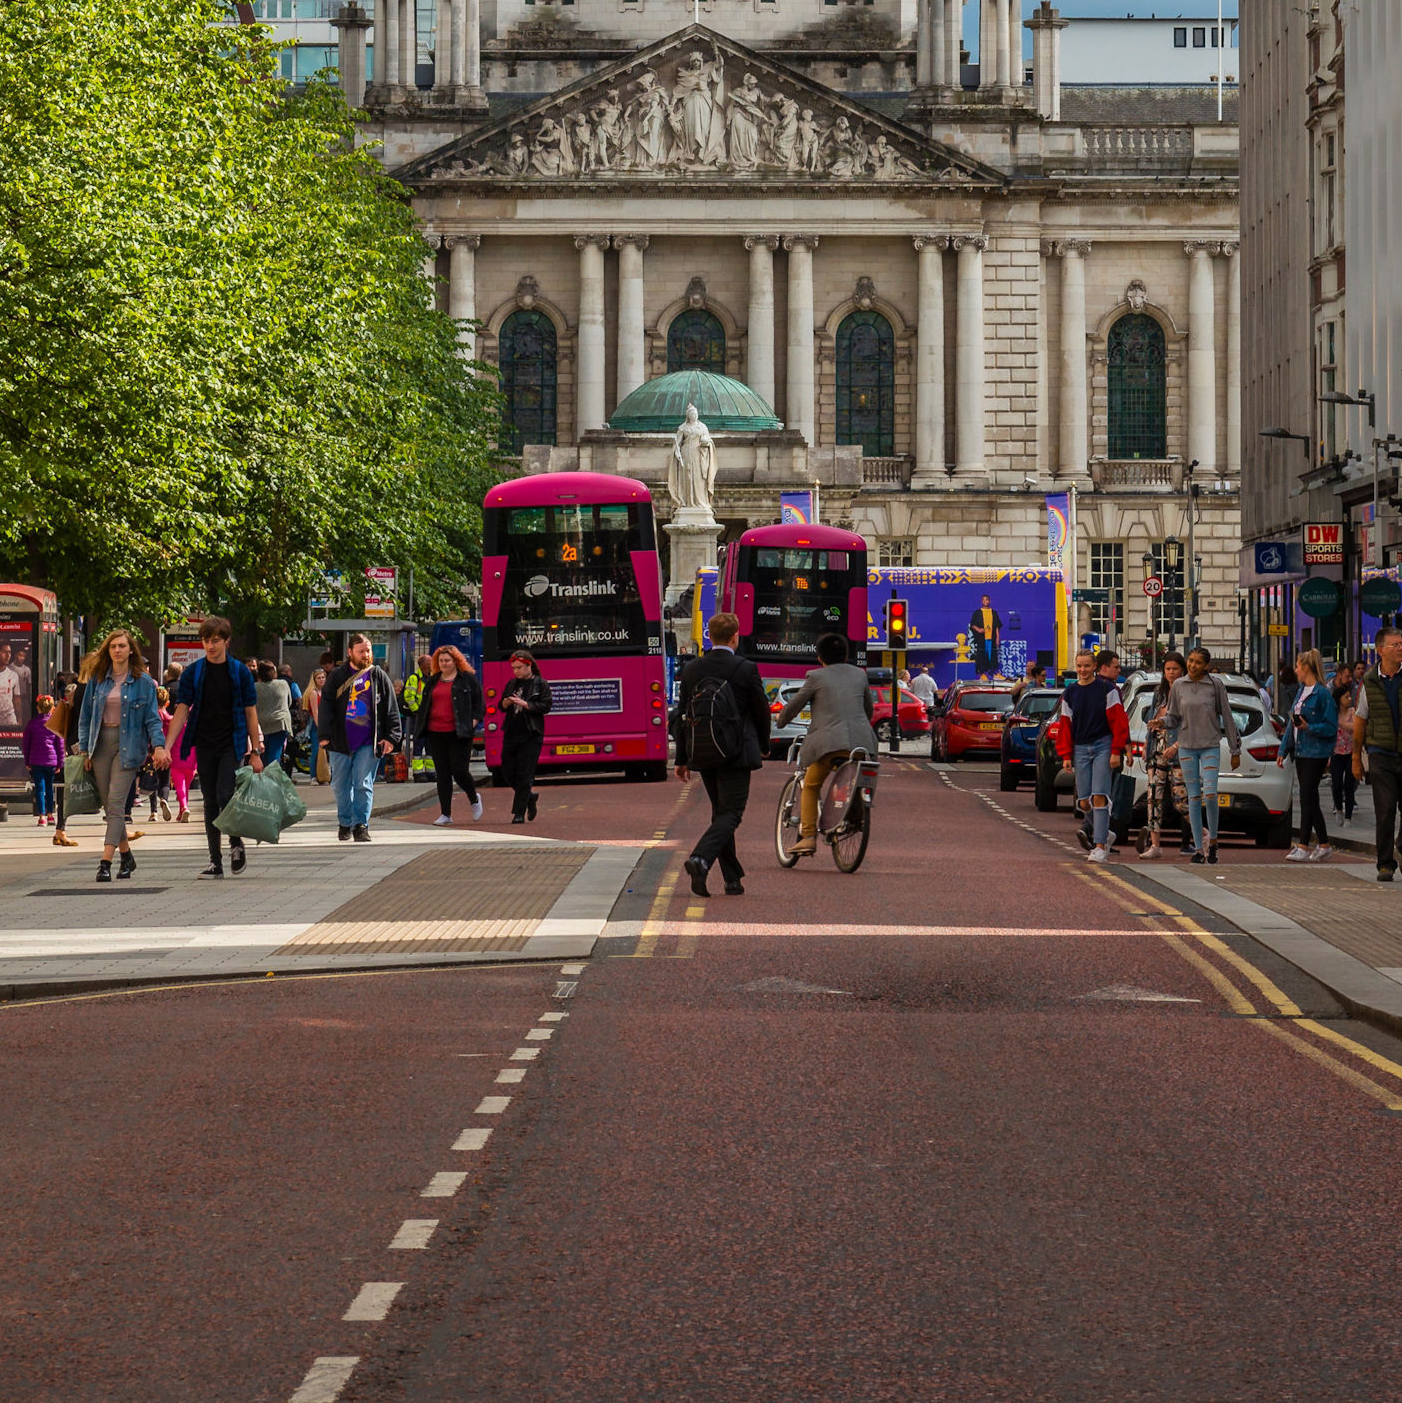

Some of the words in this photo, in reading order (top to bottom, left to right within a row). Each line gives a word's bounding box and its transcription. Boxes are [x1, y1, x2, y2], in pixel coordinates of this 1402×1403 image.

[1308, 525, 1339, 543] DW
[562, 543, 577, 561] 2a
[1305, 544, 1342, 553] SPORTS
[1305, 553, 1342, 563] STORES
[549, 580, 617, 597] Translink
[1146, 582, 1160, 591] 20
[515, 629, 629, 644] www.translink.co.uk
[756, 643, 817, 652] www.translink
